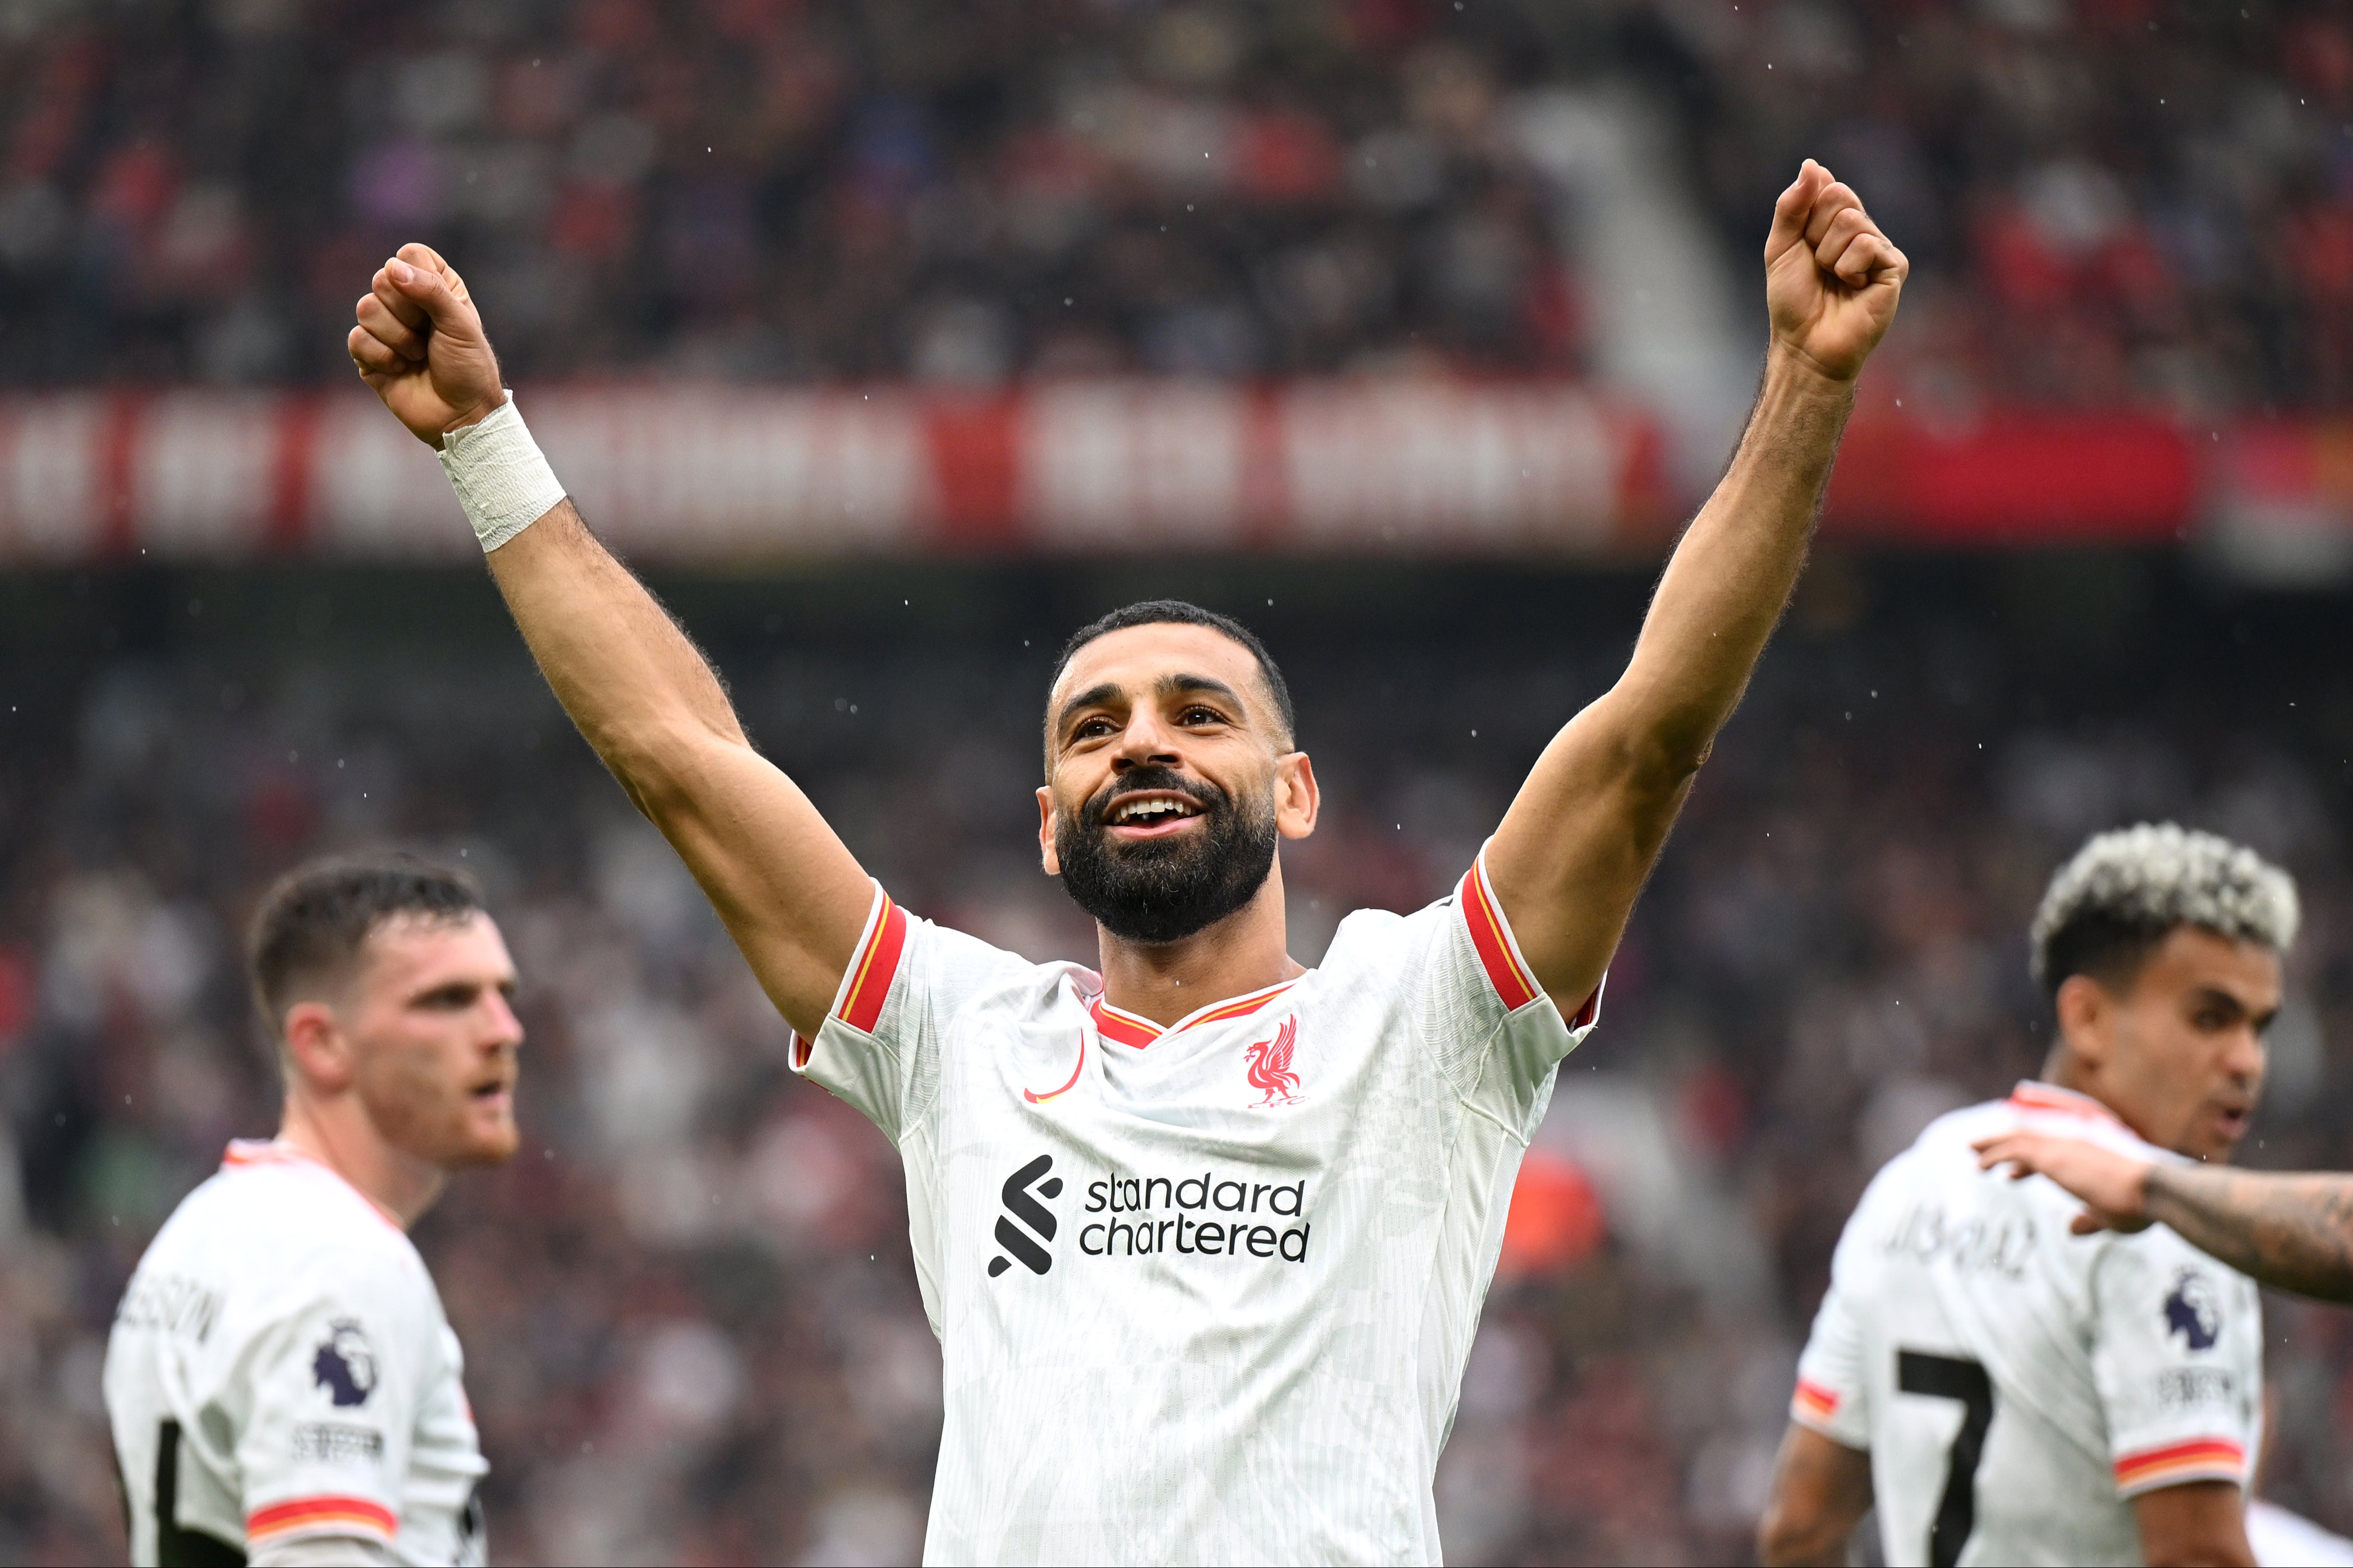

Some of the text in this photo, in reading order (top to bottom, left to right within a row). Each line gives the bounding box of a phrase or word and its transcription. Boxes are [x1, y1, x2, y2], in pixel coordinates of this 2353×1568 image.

[1085, 1172, 1305, 1217] standard
[1079, 1212, 1310, 1263] chartered
[1897, 1349, 1993, 1566] 7
